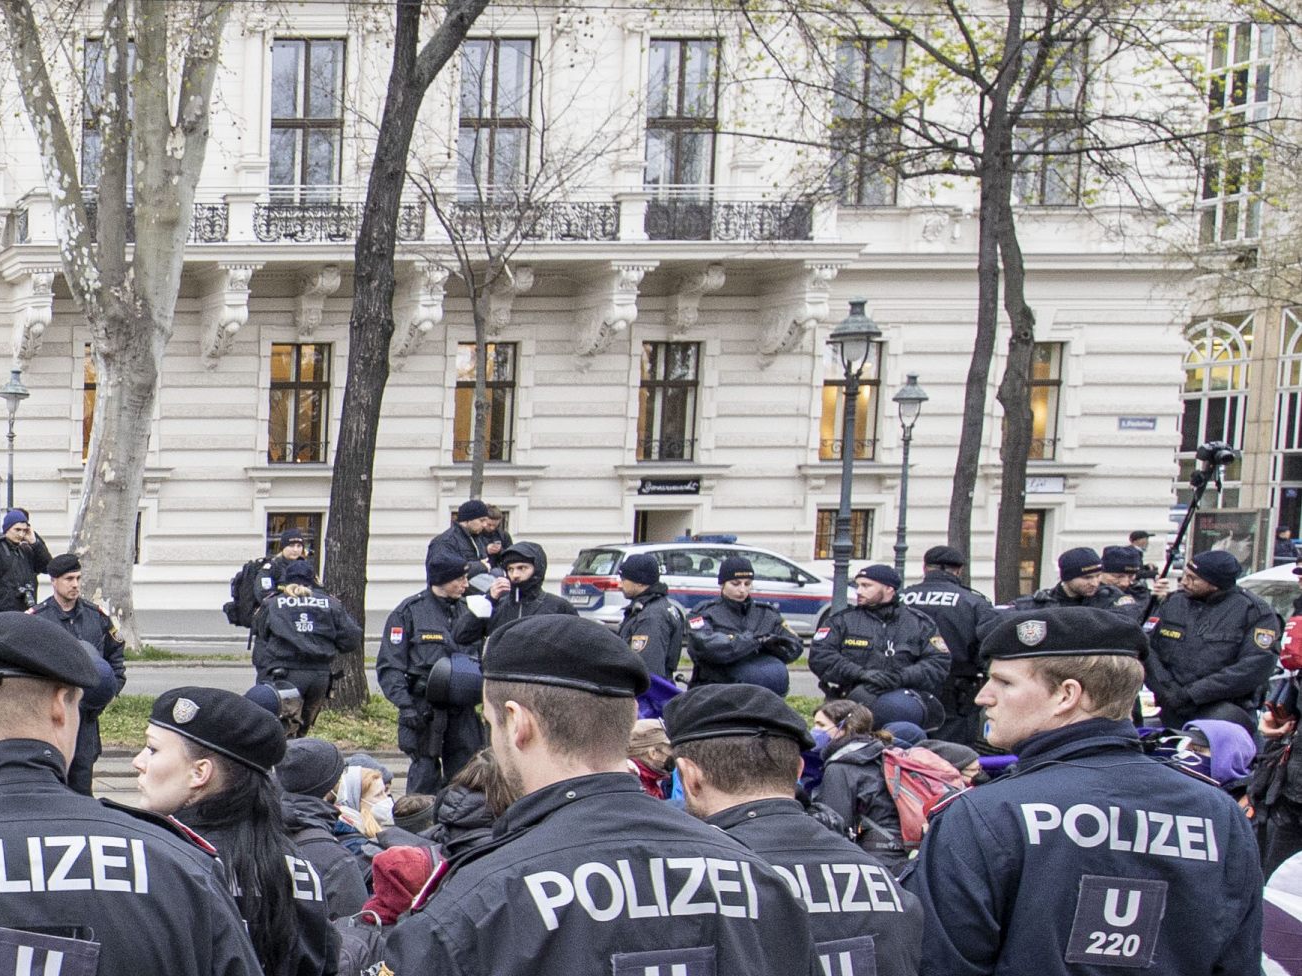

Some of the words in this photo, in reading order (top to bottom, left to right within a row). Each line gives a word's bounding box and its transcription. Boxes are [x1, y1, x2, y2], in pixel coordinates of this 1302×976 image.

[277, 597, 329, 609] POLIZEI
[1020, 803, 1219, 862] POLIZEI
[524, 857, 759, 931] POLIZEI
[772, 864, 904, 913] LIZEI
[1103, 888, 1141, 927] U
[1085, 931, 1141, 957] 220
